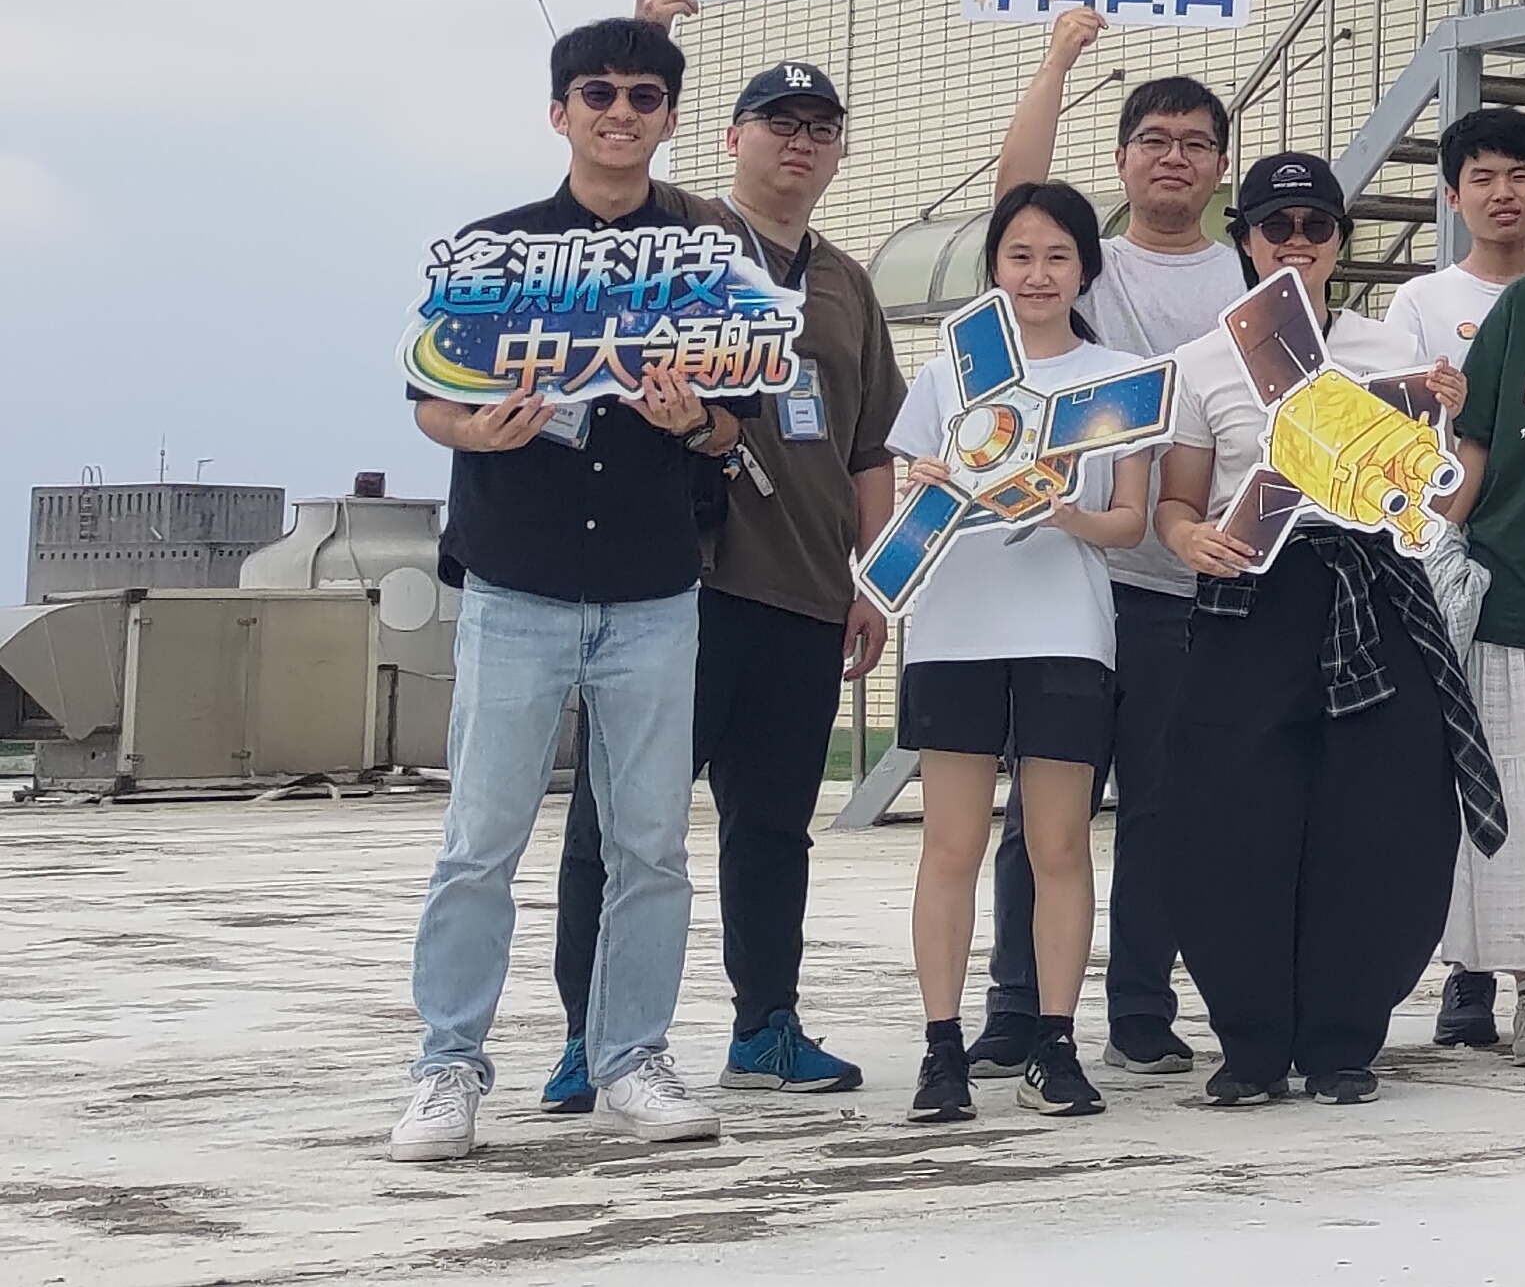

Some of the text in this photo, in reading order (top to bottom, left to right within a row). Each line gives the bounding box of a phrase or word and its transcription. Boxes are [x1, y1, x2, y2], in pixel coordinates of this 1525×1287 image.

[783, 65, 812, 88] LA
[421, 234, 735, 317] 遙測科技
[494, 313, 792, 394] 中大領航
